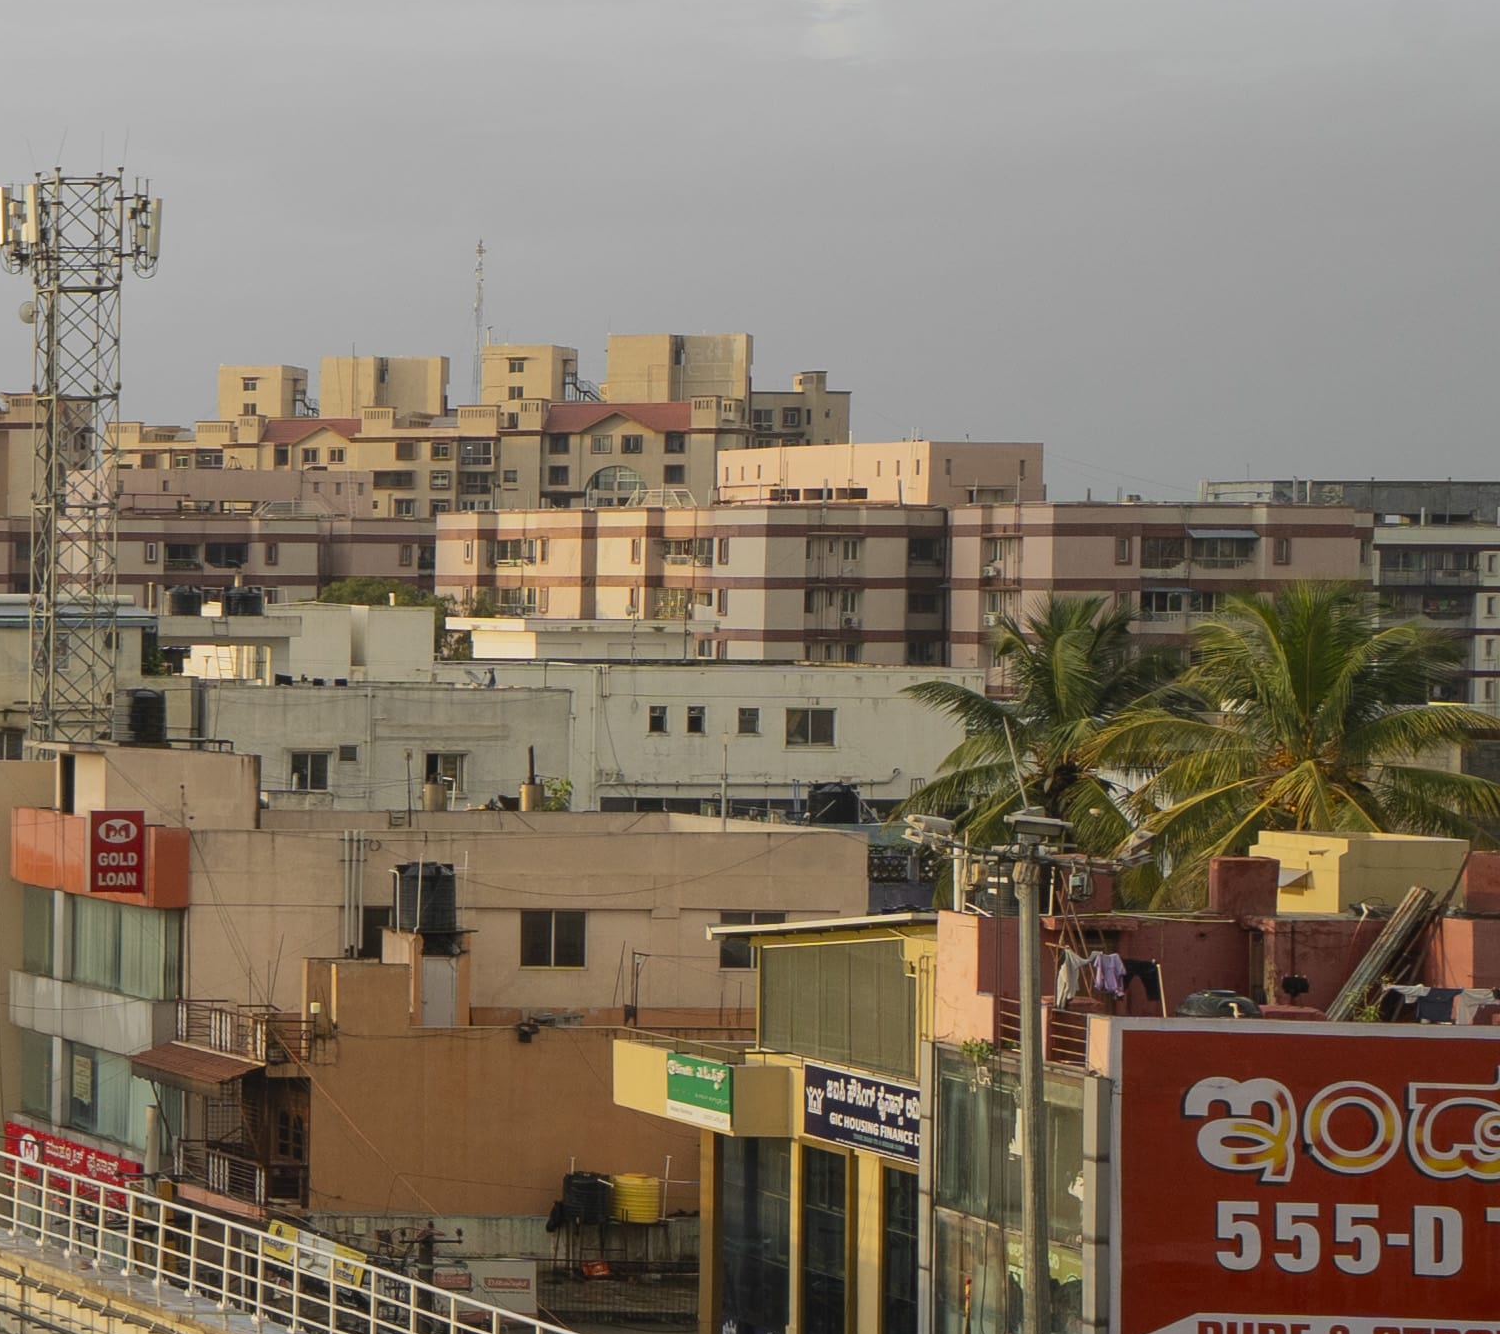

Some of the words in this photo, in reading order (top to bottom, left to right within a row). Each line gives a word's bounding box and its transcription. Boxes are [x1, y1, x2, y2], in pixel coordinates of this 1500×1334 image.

[97, 852, 138, 866] GOLD
[97, 872, 137, 886] LOAN
[829, 1112, 843, 1128] GIC
[843, 1117, 879, 1135] HOUSING
[880, 1125, 913, 1145] FINANCE
[1215, 1200, 1464, 1278] 555-D
